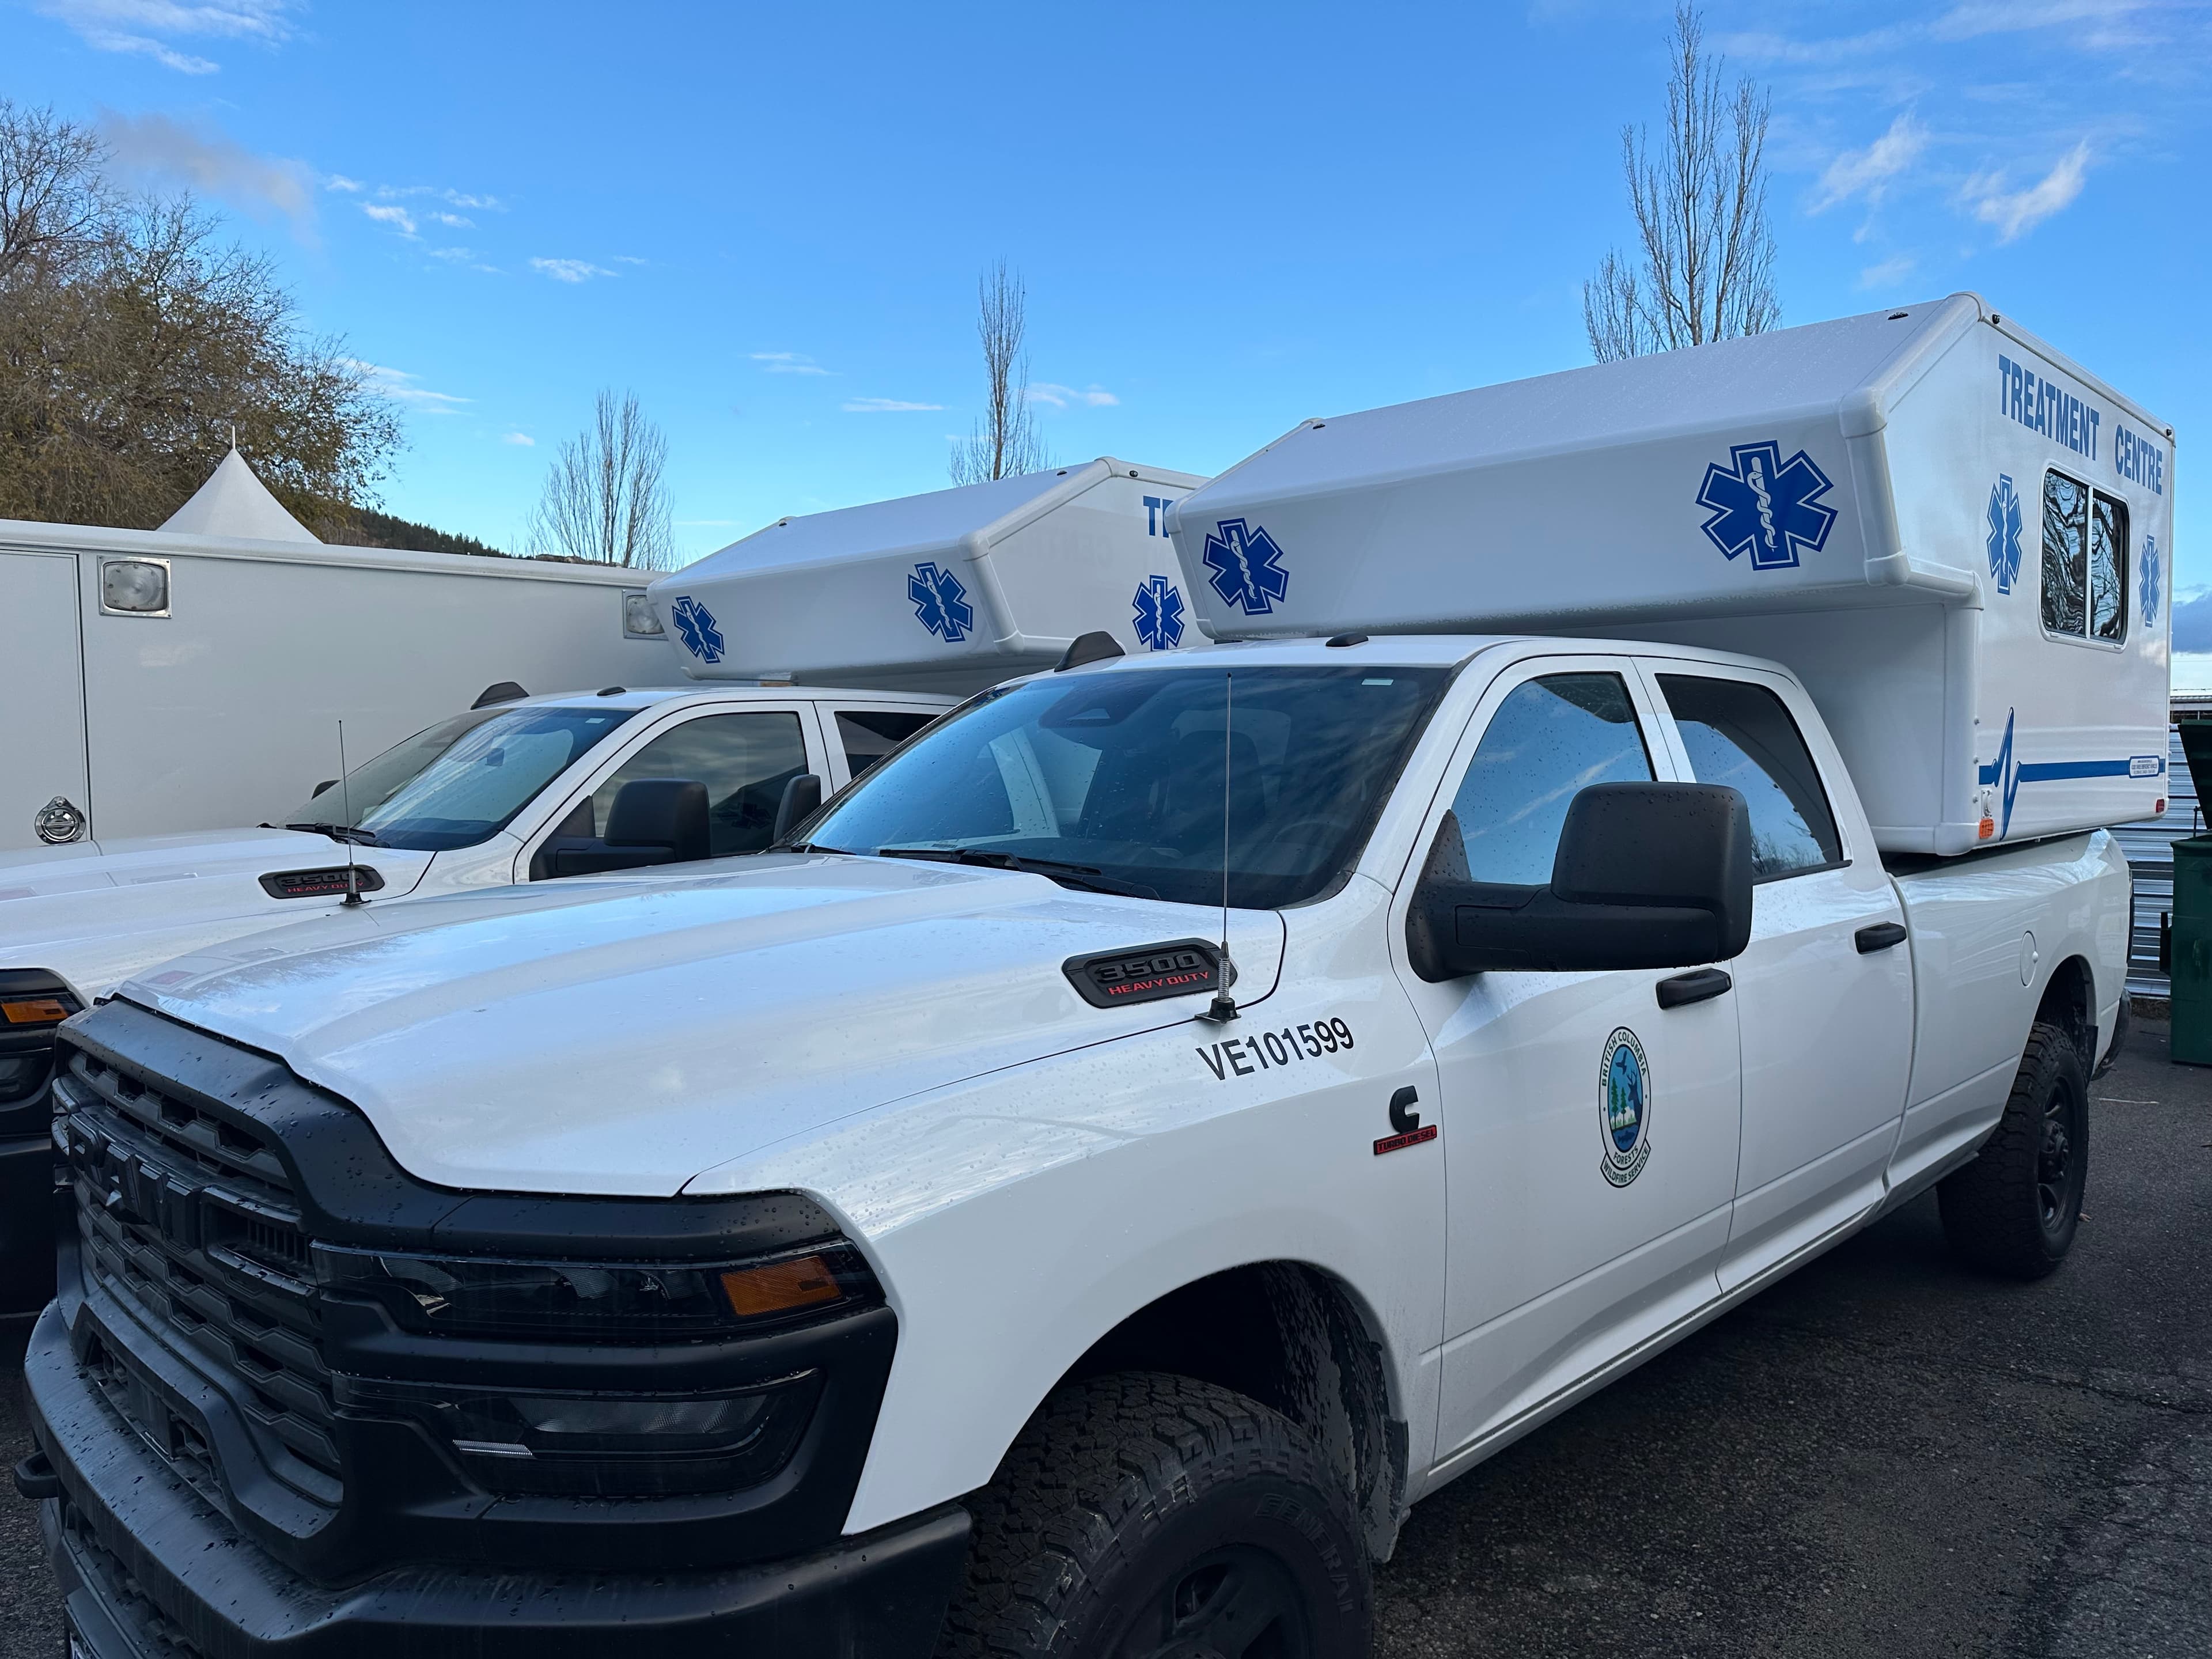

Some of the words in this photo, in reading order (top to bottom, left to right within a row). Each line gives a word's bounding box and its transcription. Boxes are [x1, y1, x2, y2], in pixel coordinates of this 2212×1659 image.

[1998, 353, 2100, 461] TREATMENT
[2115, 423, 2162, 495] CENTRE
[286, 884, 328, 893] HEAVY
[330, 881, 364, 889] DUY
[1095, 953, 1201, 983] 3500
[1108, 979, 1163, 995] HEAVY
[1166, 971, 1209, 985] DUTY
[1195, 1017, 1354, 1081] VE101599
[1601, 1036, 1618, 1086] BRITISH
[1618, 1032, 1646, 1076] COLUMBIA
[1604, 1160, 1627, 1184] WILDFIRE
[1628, 1146, 1648, 1180] SERVICE
[1613, 1145, 1638, 1165] FORESTS
[1253, 1493, 1354, 1629] GENERAL
